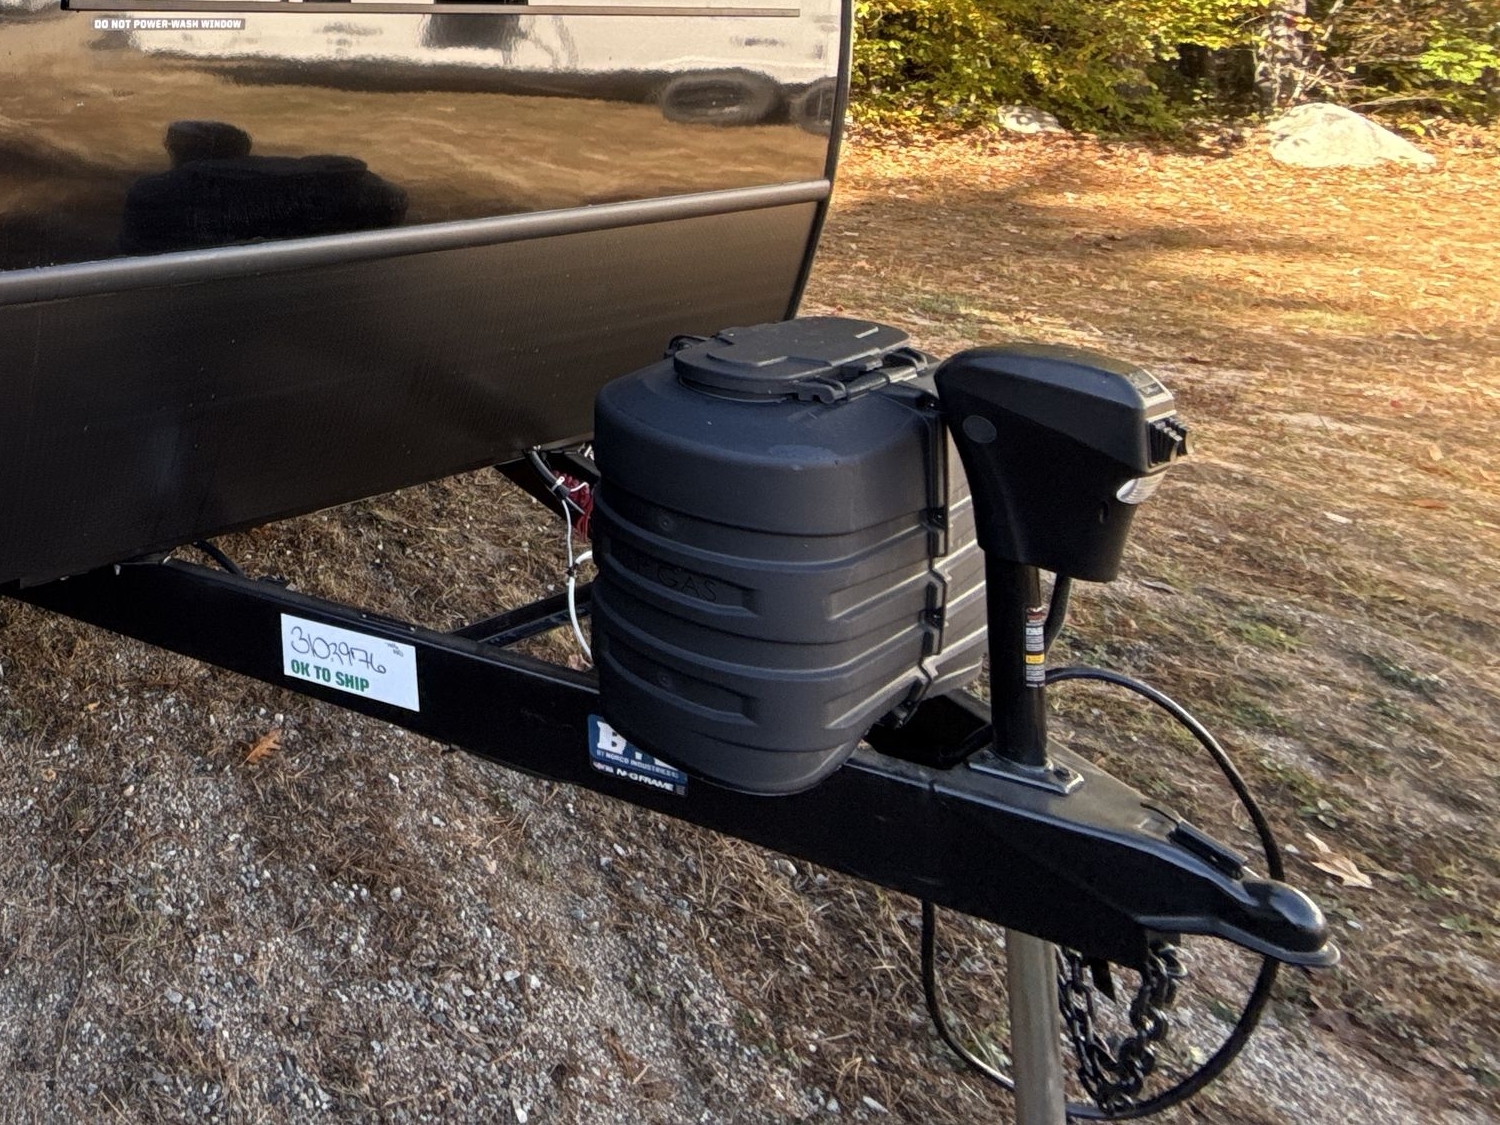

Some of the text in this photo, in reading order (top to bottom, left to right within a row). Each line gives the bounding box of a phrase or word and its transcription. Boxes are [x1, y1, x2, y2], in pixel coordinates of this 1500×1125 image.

[93, 19, 242, 29] DO NOT POWER-WASH WINDOW
[291, 659, 370, 693] OK TO SHIP
